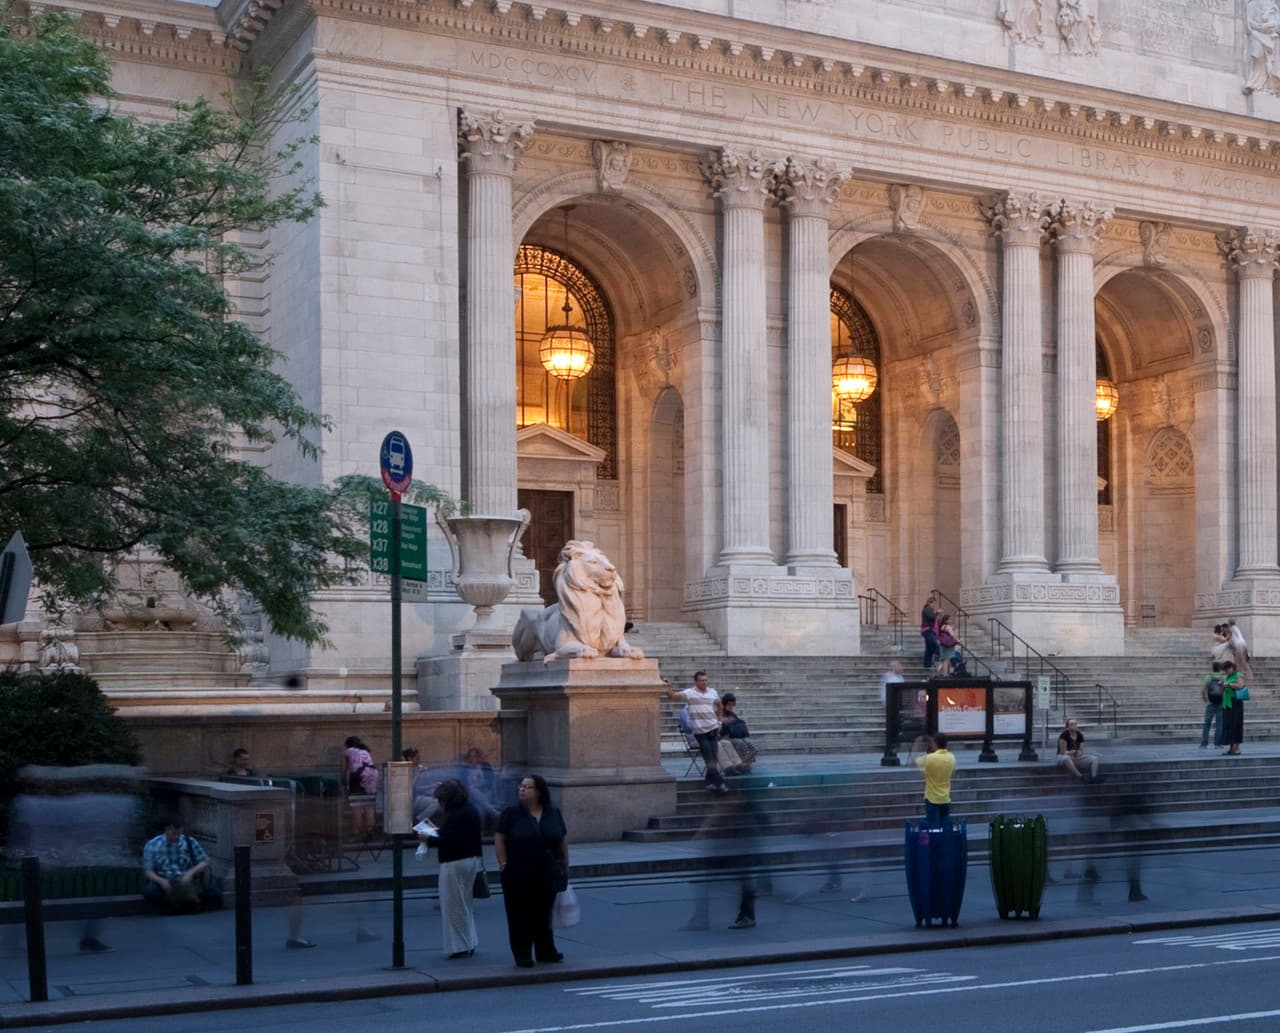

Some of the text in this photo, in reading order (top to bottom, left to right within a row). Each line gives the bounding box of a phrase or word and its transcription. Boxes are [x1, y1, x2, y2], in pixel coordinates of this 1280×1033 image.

[469, 49, 595, 85] MDCCCXCV
[664, 78, 728, 109] THE
[751, 93, 824, 123] NEW
[847, 108, 920, 142] YORK
[943, 126, 1034, 159] PUBLIC
[1056, 142, 1154, 179] LIBRARY
